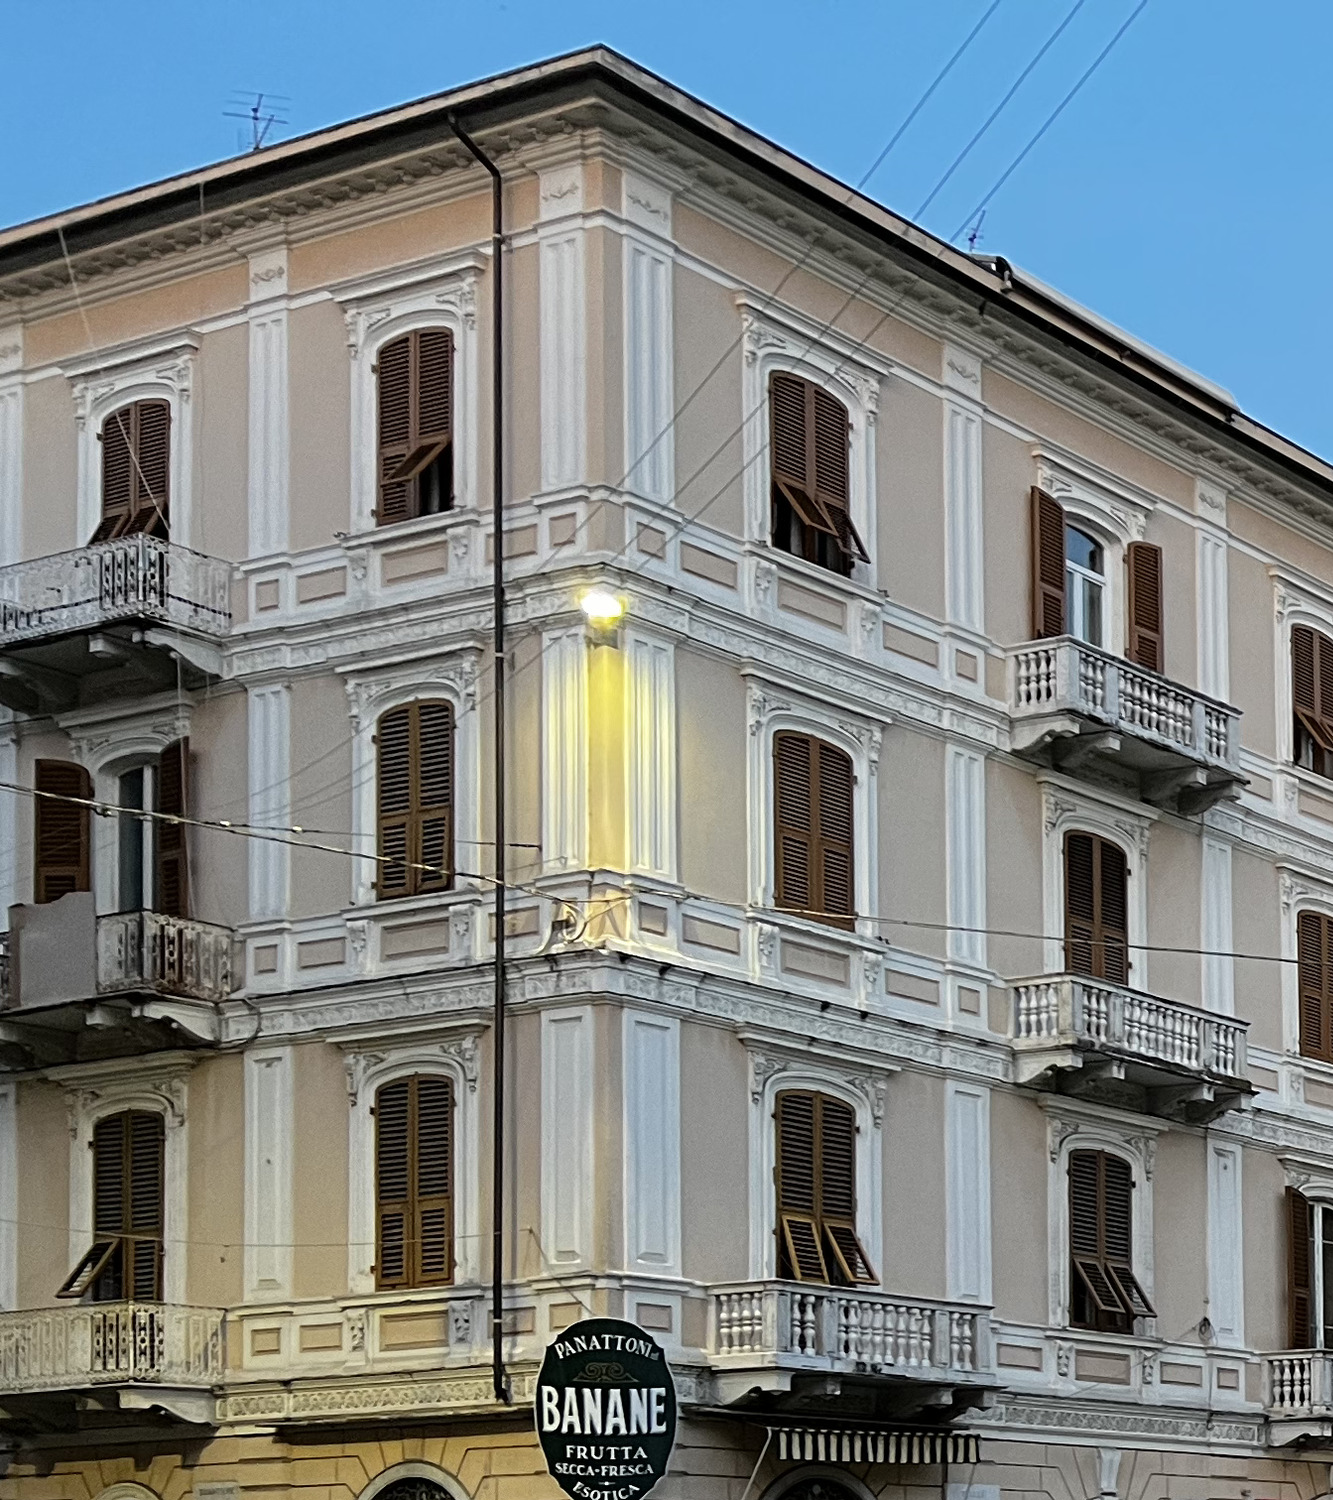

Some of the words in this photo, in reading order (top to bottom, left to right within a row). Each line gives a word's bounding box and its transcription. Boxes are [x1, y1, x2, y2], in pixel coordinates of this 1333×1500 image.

[541, 1385, 667, 1435] BANANE
[565, 1445, 648, 1460] FRUTTA
[555, 1462, 654, 1477] SECCA-FRESCA
